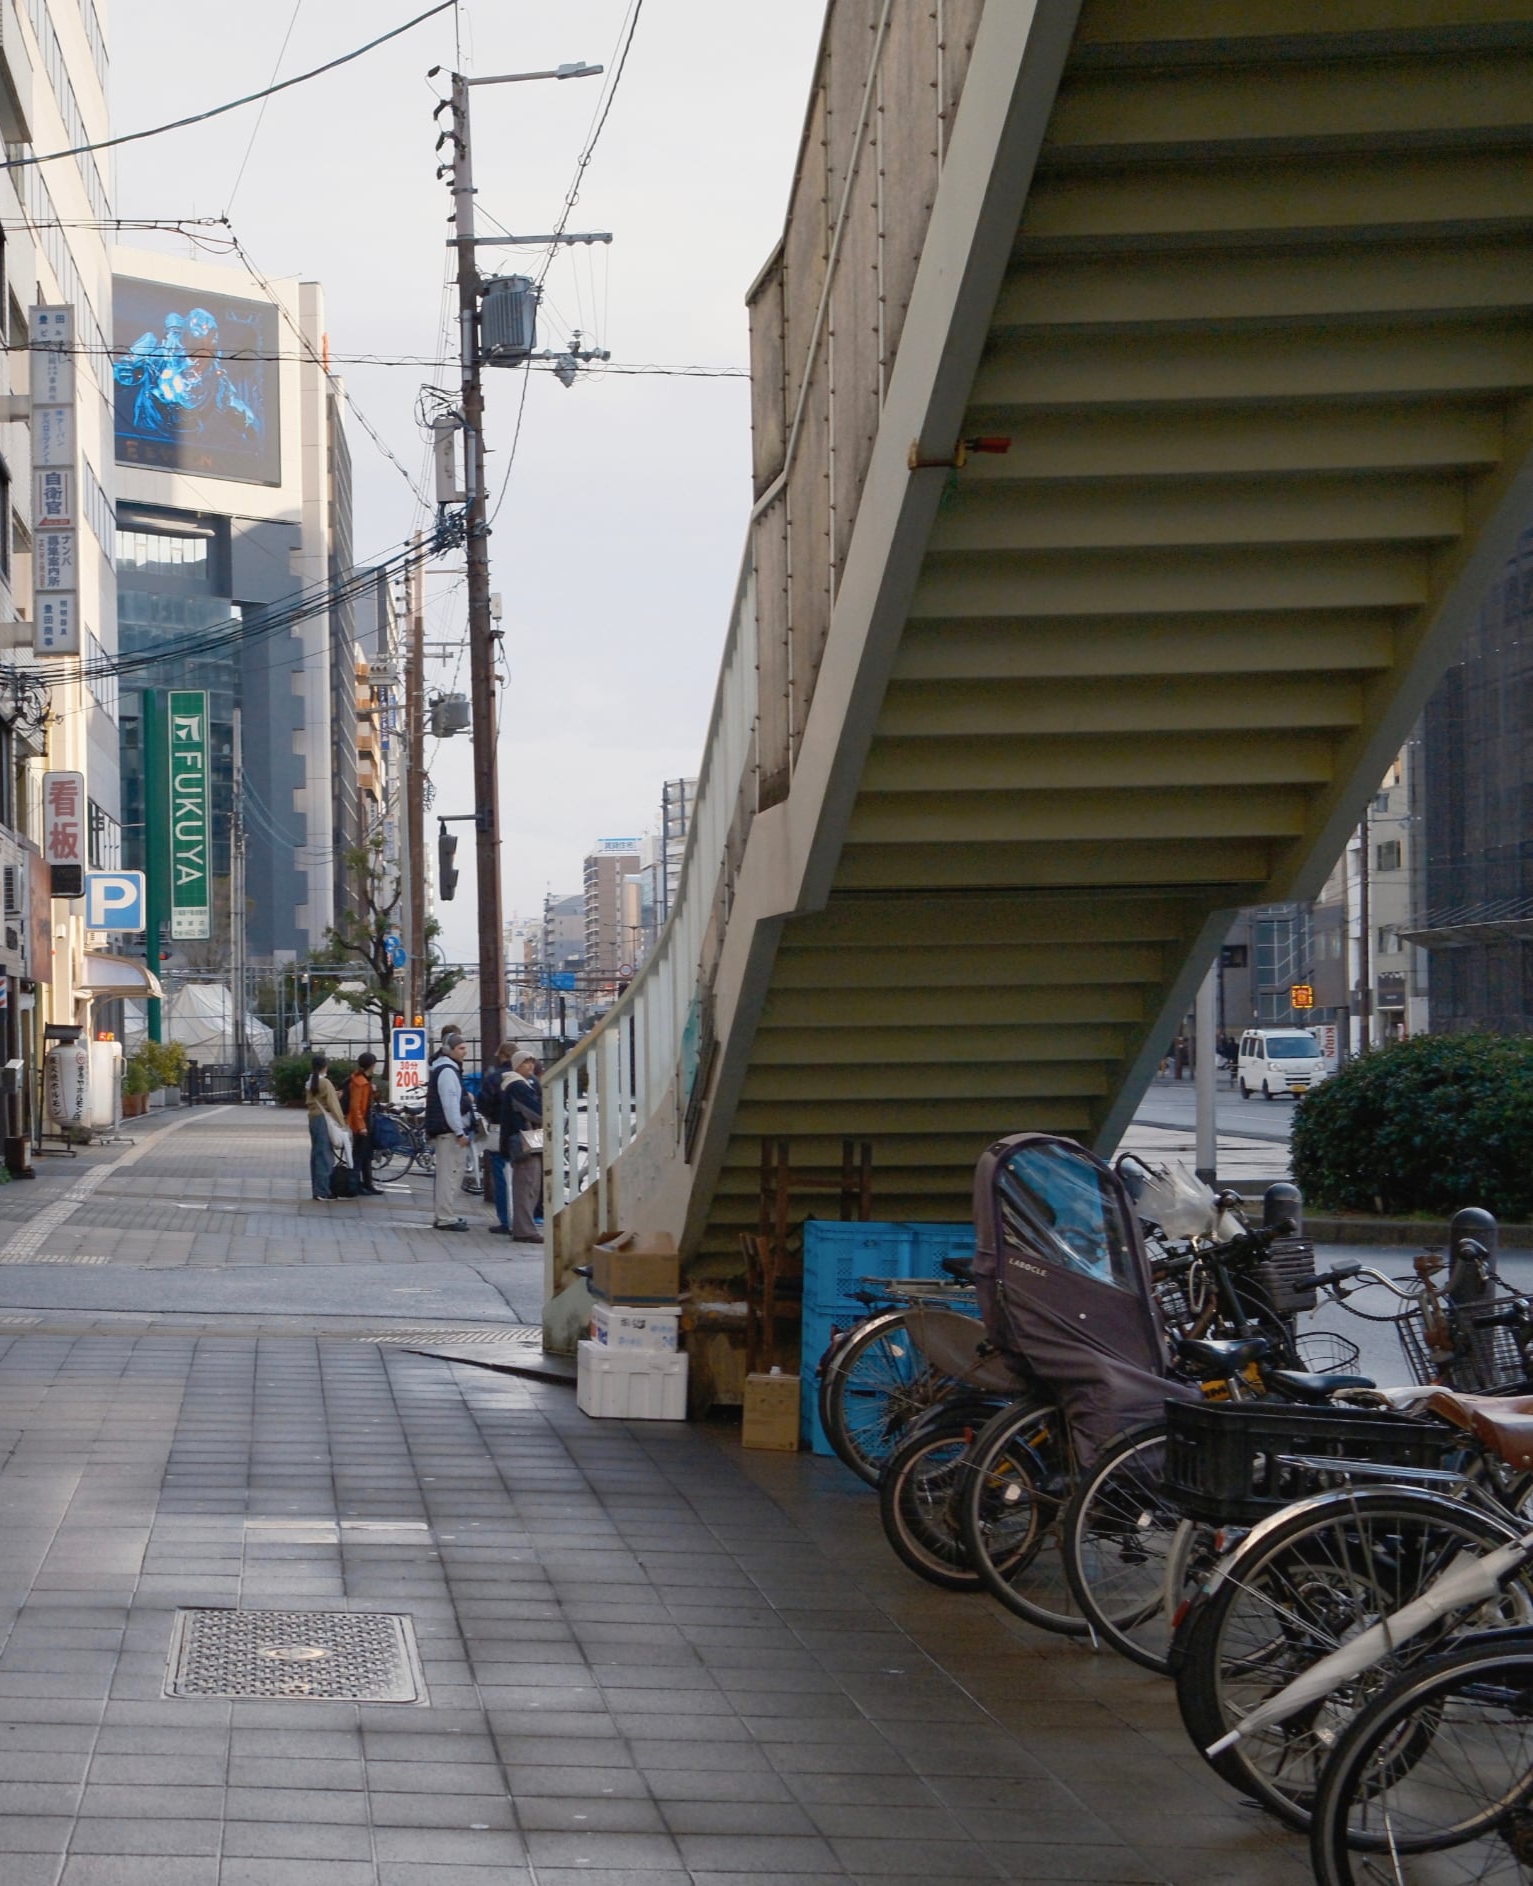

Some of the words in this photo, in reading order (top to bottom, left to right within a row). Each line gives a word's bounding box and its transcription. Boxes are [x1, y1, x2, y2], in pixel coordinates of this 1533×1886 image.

[43, 472, 62, 515] 自衛官
[48, 779, 79, 860] 看板
[174, 751, 204, 886] FUKUYA
[90, 877, 138, 925] P
[398, 1033, 422, 1058] P
[1008, 1257, 1047, 1277] LABOCLE
